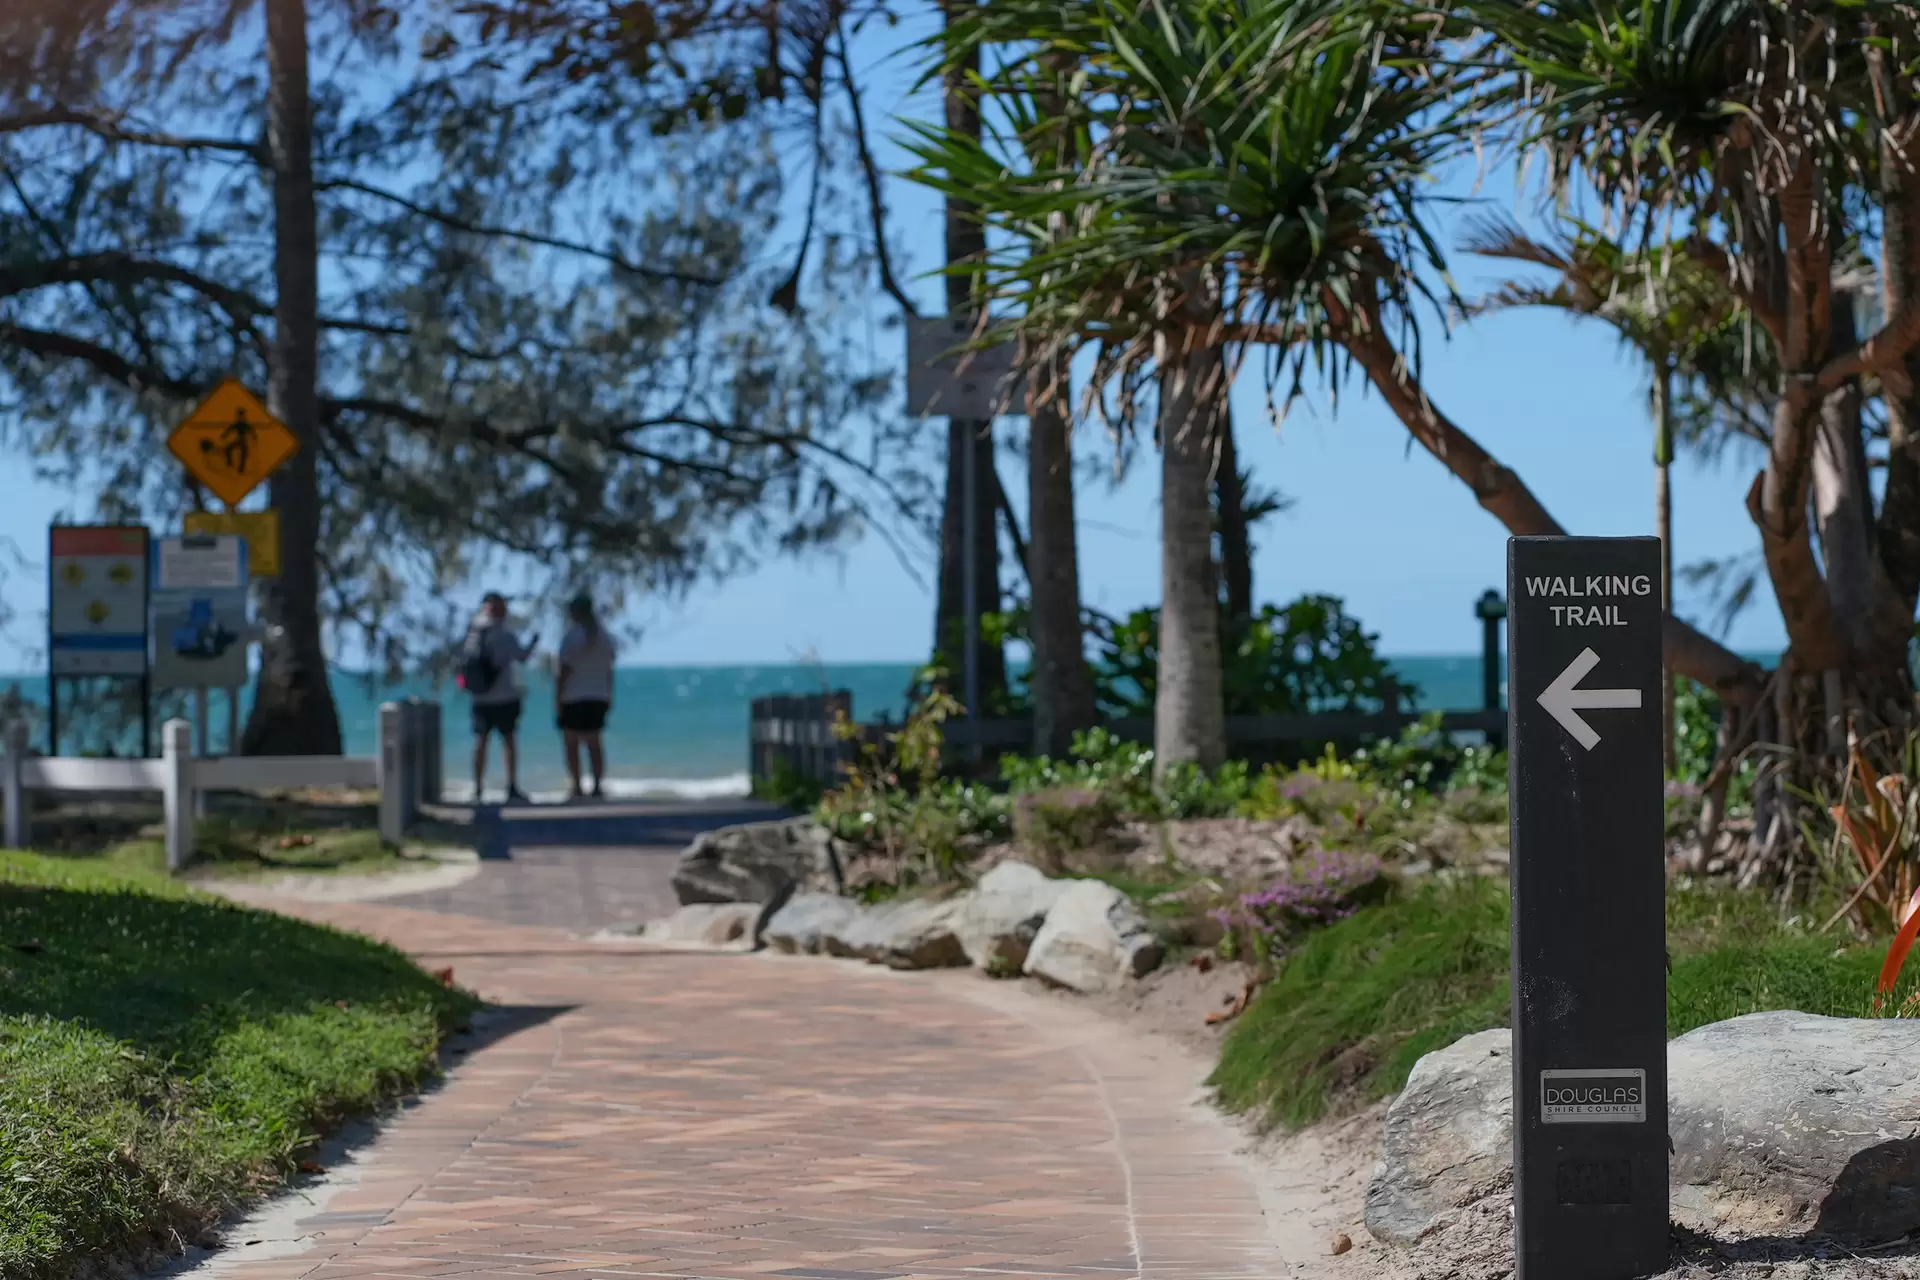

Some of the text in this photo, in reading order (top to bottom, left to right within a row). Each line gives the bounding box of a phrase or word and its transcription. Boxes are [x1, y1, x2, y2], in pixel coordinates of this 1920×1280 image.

[1525, 575, 1651, 596] WALKING
[1550, 605, 1628, 626] TRAIL
[1546, 1087, 1639, 1104] DOUGLAS
